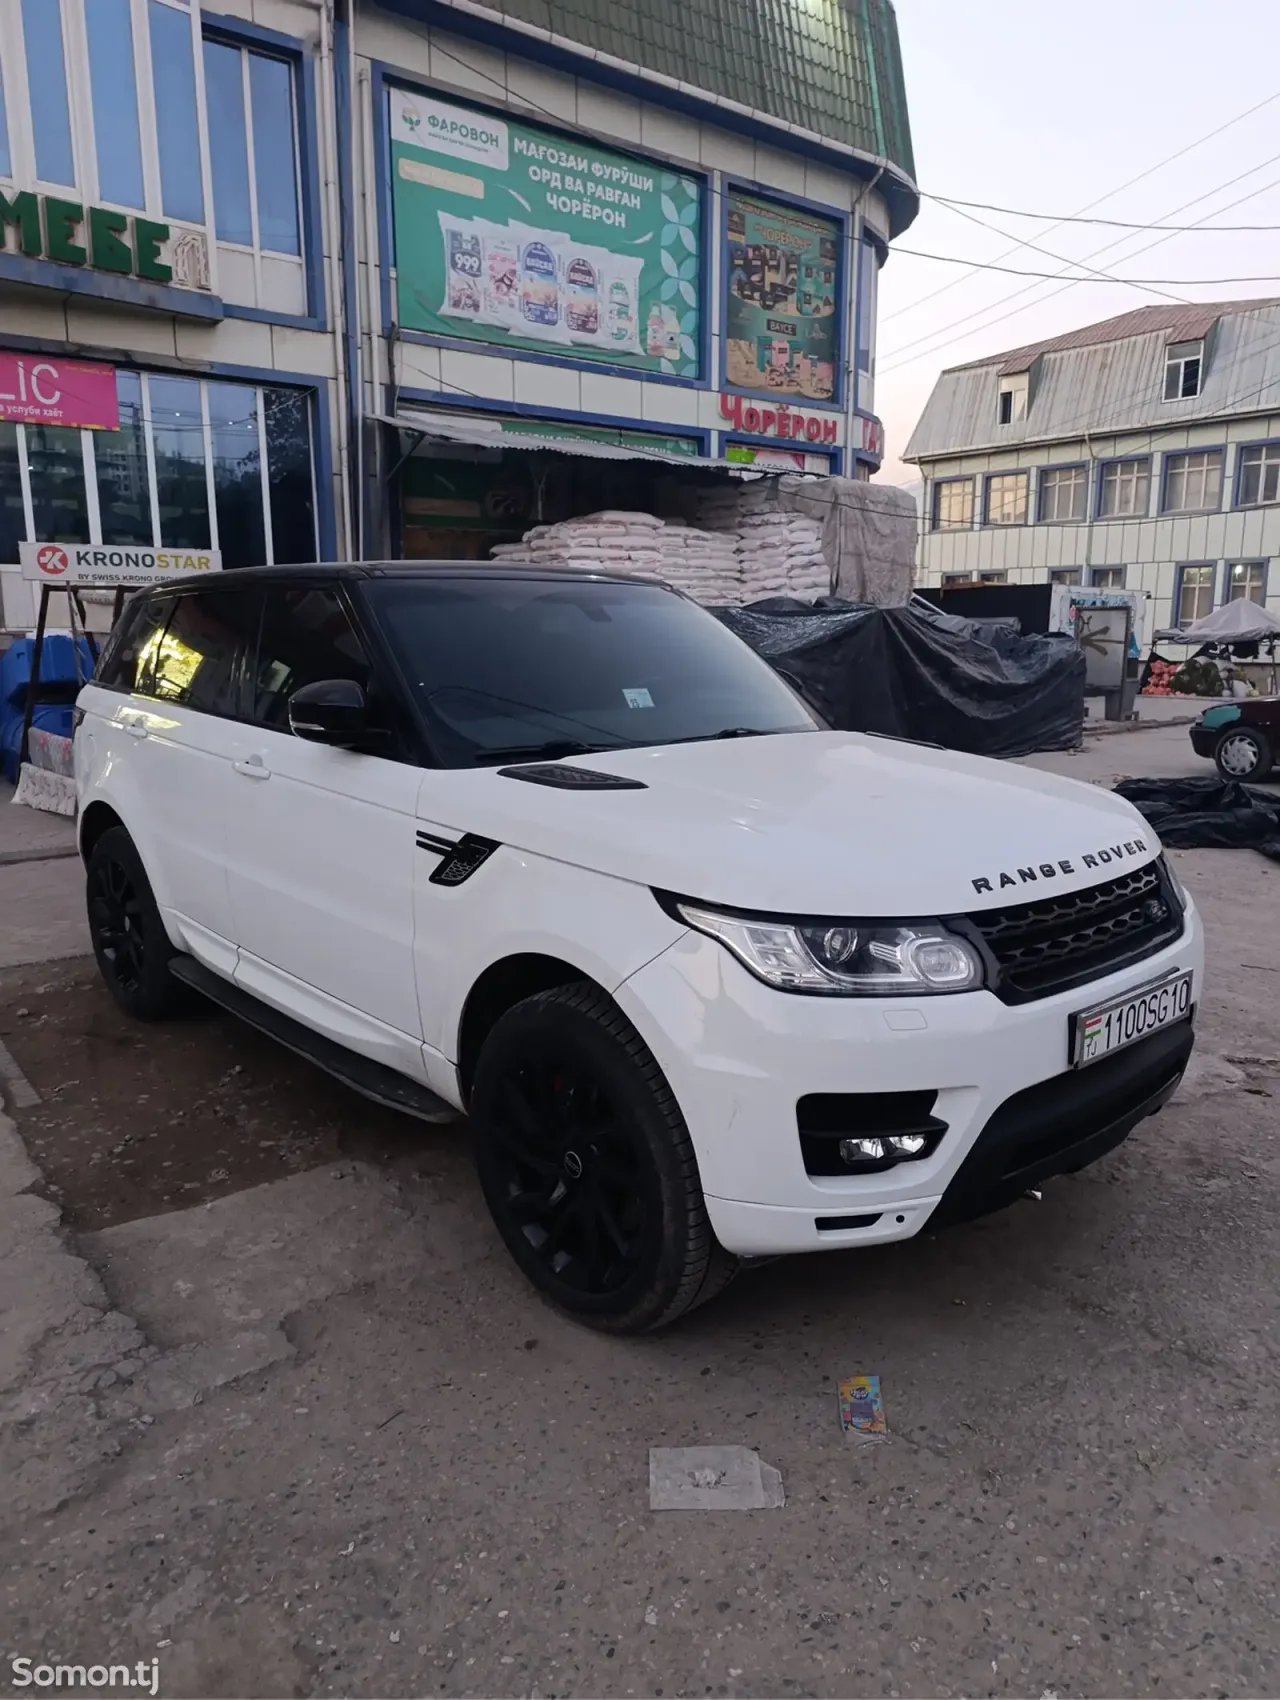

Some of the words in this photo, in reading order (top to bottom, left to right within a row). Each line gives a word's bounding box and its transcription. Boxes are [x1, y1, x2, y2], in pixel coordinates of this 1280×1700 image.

[427, 115, 499, 149] ФАРОВОН
[528, 165, 562, 190] ОРД
[564, 174, 585, 194] ВА
[546, 191, 626, 229] ЧОРЁРОН
[454, 252, 480, 273] 999
[718, 392, 838, 444] ЧОРЁРОН
[76, 550, 211, 569] KRONOSTAR
[78, 573, 89, 581] BY
[91, 573, 121, 582] SWISS
[122, 574, 153, 583] KRONO
[971, 859, 1075, 895] RANGE
[1081, 838, 1148, 869] ROVER
